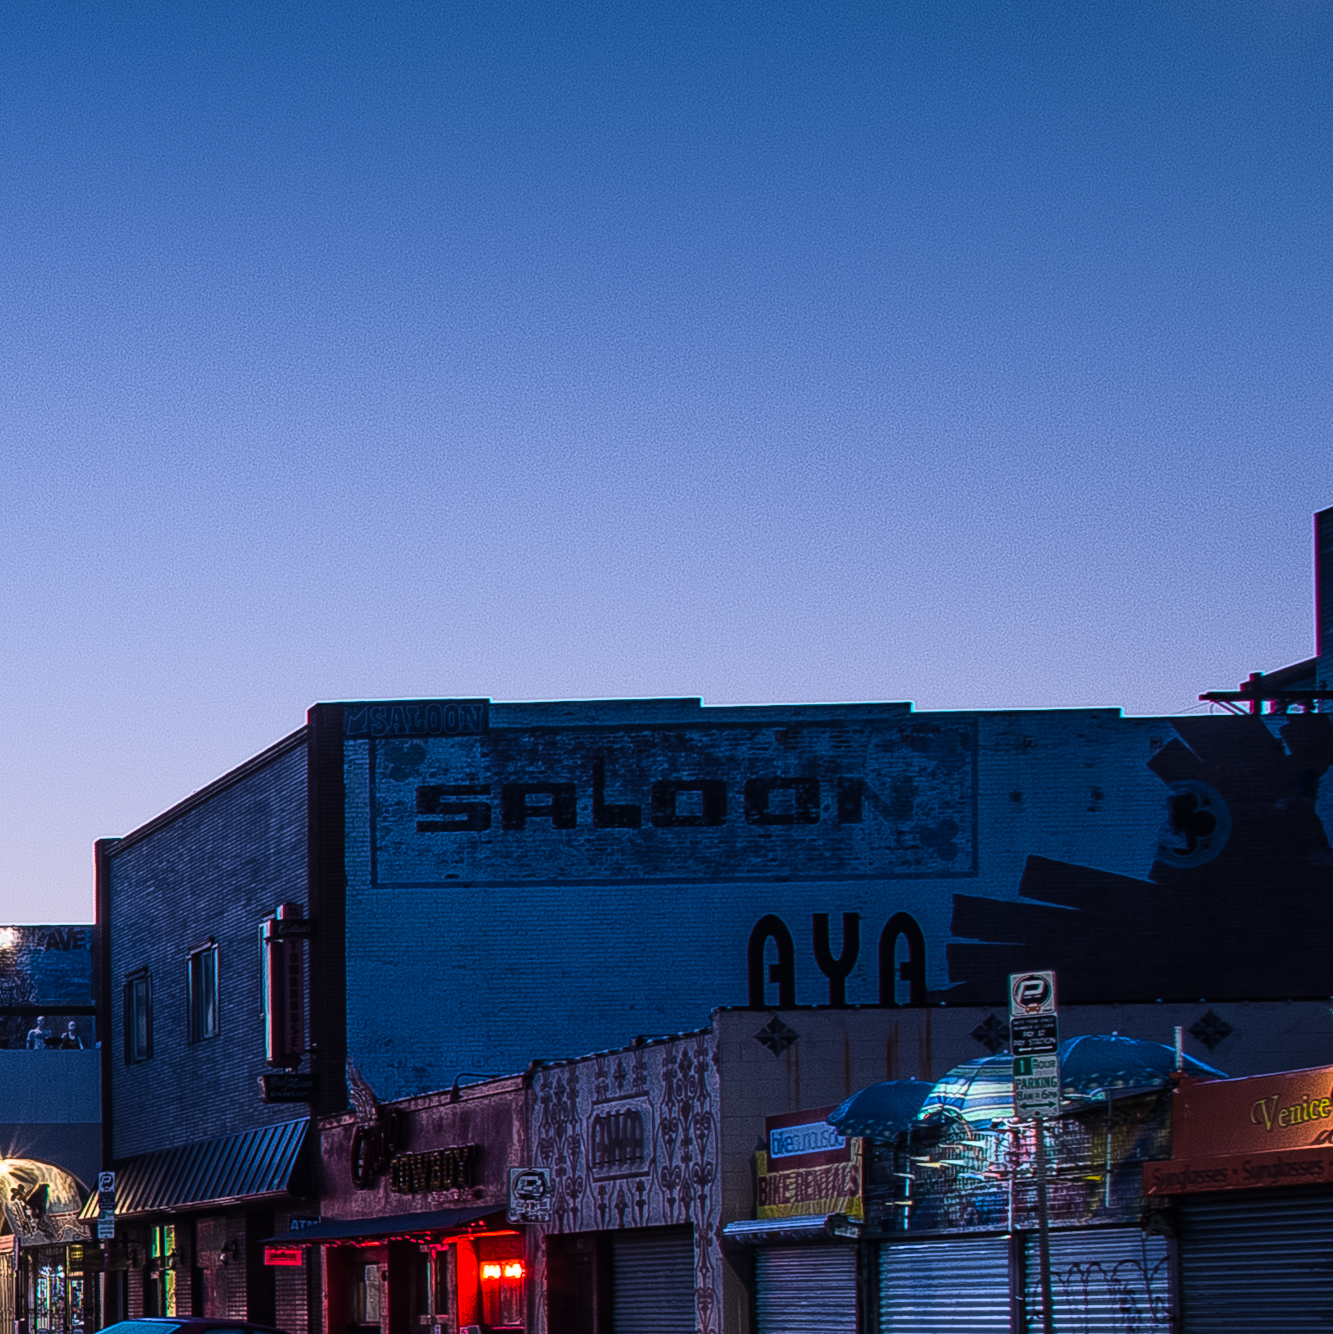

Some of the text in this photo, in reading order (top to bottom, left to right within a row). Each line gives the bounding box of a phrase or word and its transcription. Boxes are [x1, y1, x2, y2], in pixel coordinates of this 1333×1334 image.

[370, 703, 484, 736] SALOON
[747, 911, 925, 1007] AYA
[1027, 1037, 1056, 1046] STATION
[1015, 1076, 1059, 1089] PARKING
[1250, 1092, 1331, 1132] Venice
[389, 1141, 476, 1194] COWBOY
[758, 1172, 791, 1207] BIKE
